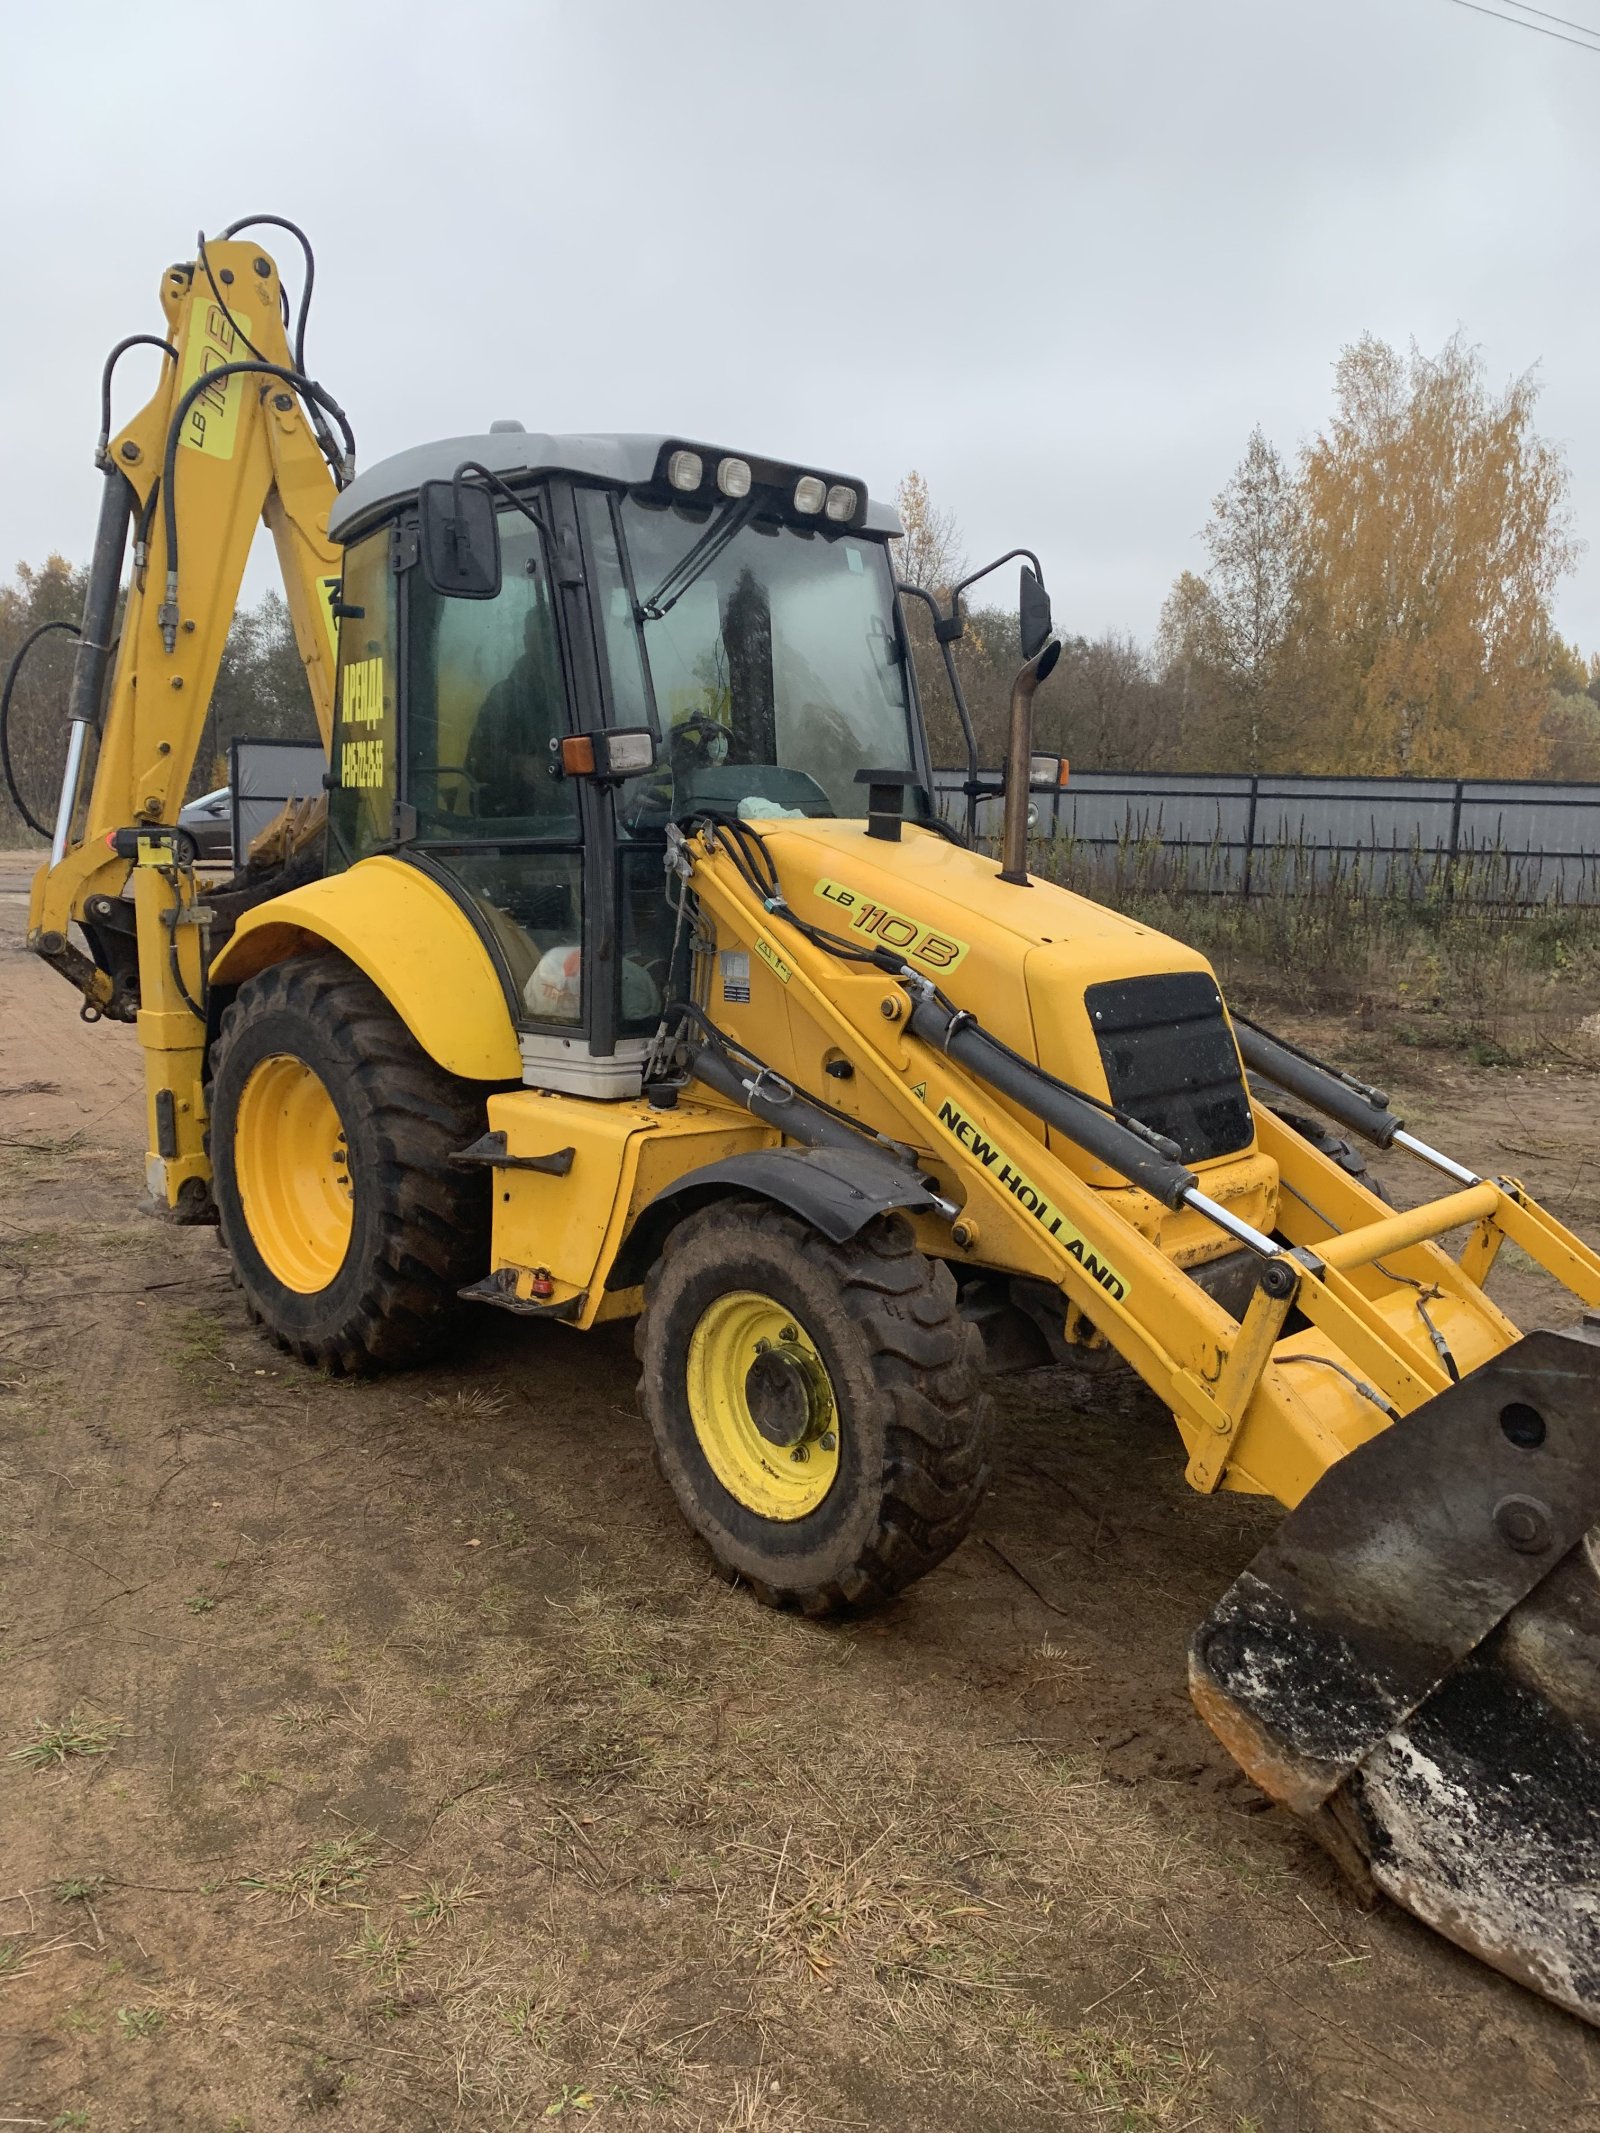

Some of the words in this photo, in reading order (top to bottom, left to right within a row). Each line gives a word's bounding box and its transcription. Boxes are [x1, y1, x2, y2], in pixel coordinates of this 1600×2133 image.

[189, 411, 207, 448] LB
[342, 657, 383, 730] АРЕНДА
[822, 885, 855, 907] LB
[938, 1101, 999, 1167] NEW
[999, 1164, 1124, 1302] HOLLAND
